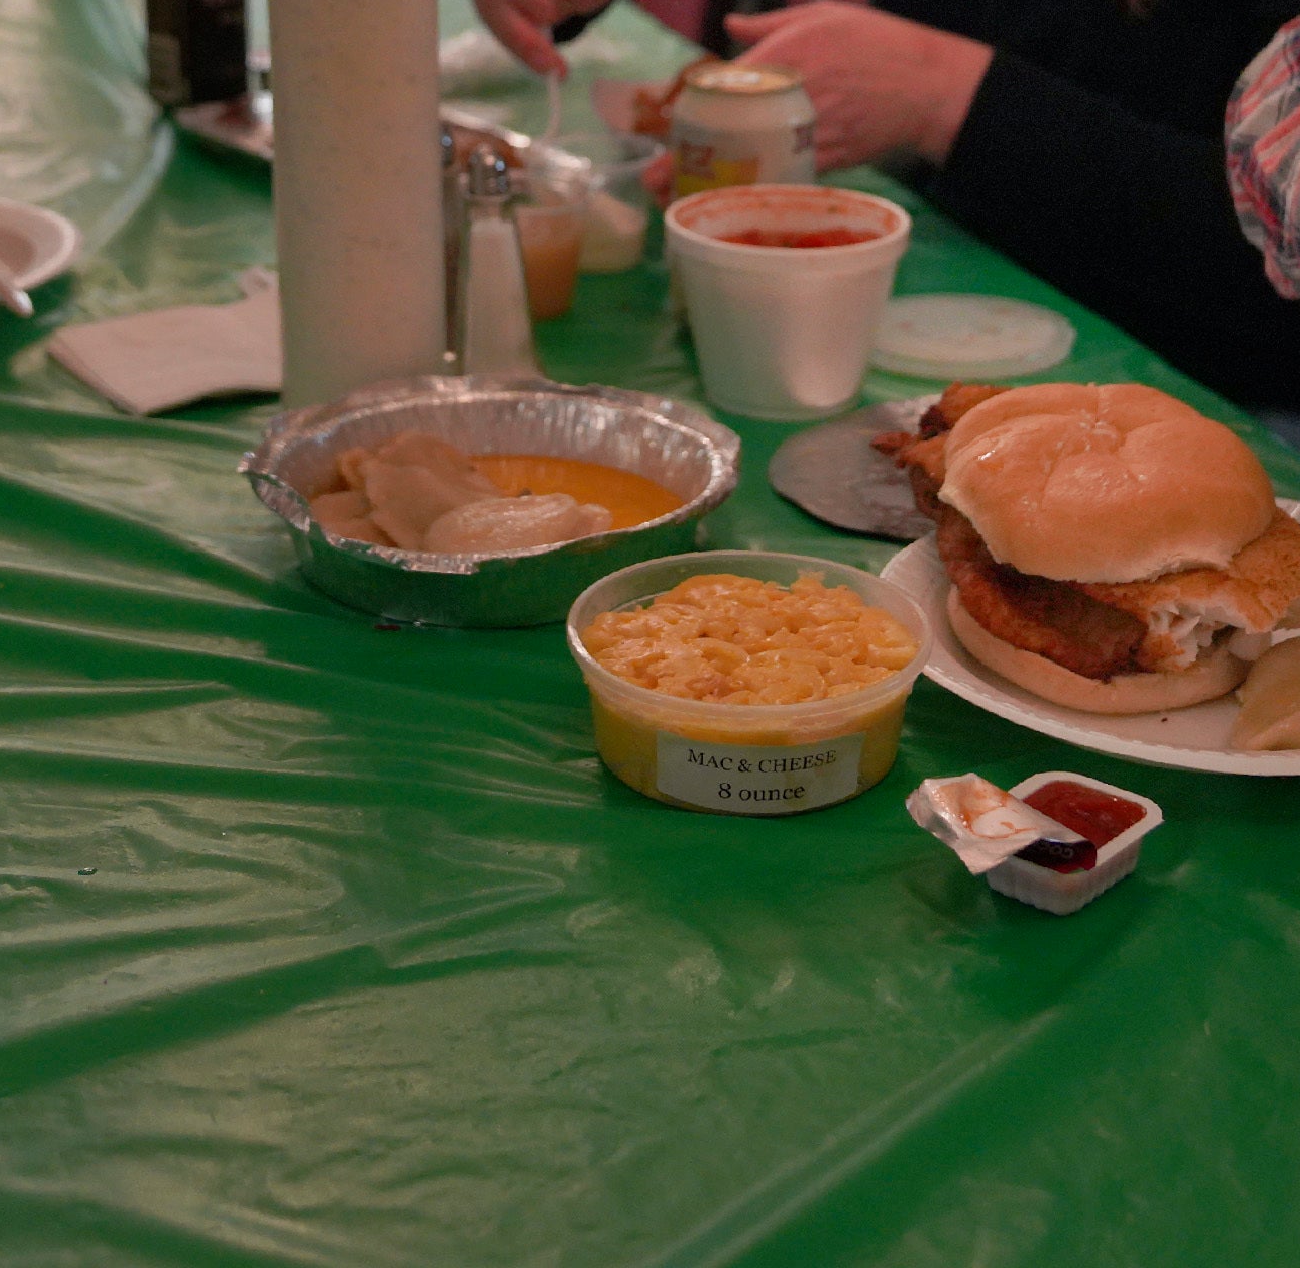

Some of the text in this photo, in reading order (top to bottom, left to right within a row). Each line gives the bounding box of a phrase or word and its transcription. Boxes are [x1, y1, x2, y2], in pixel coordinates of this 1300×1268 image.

[687, 748, 837, 773] MAC & CHEESE
[717, 782, 806, 801] 8 ounce
